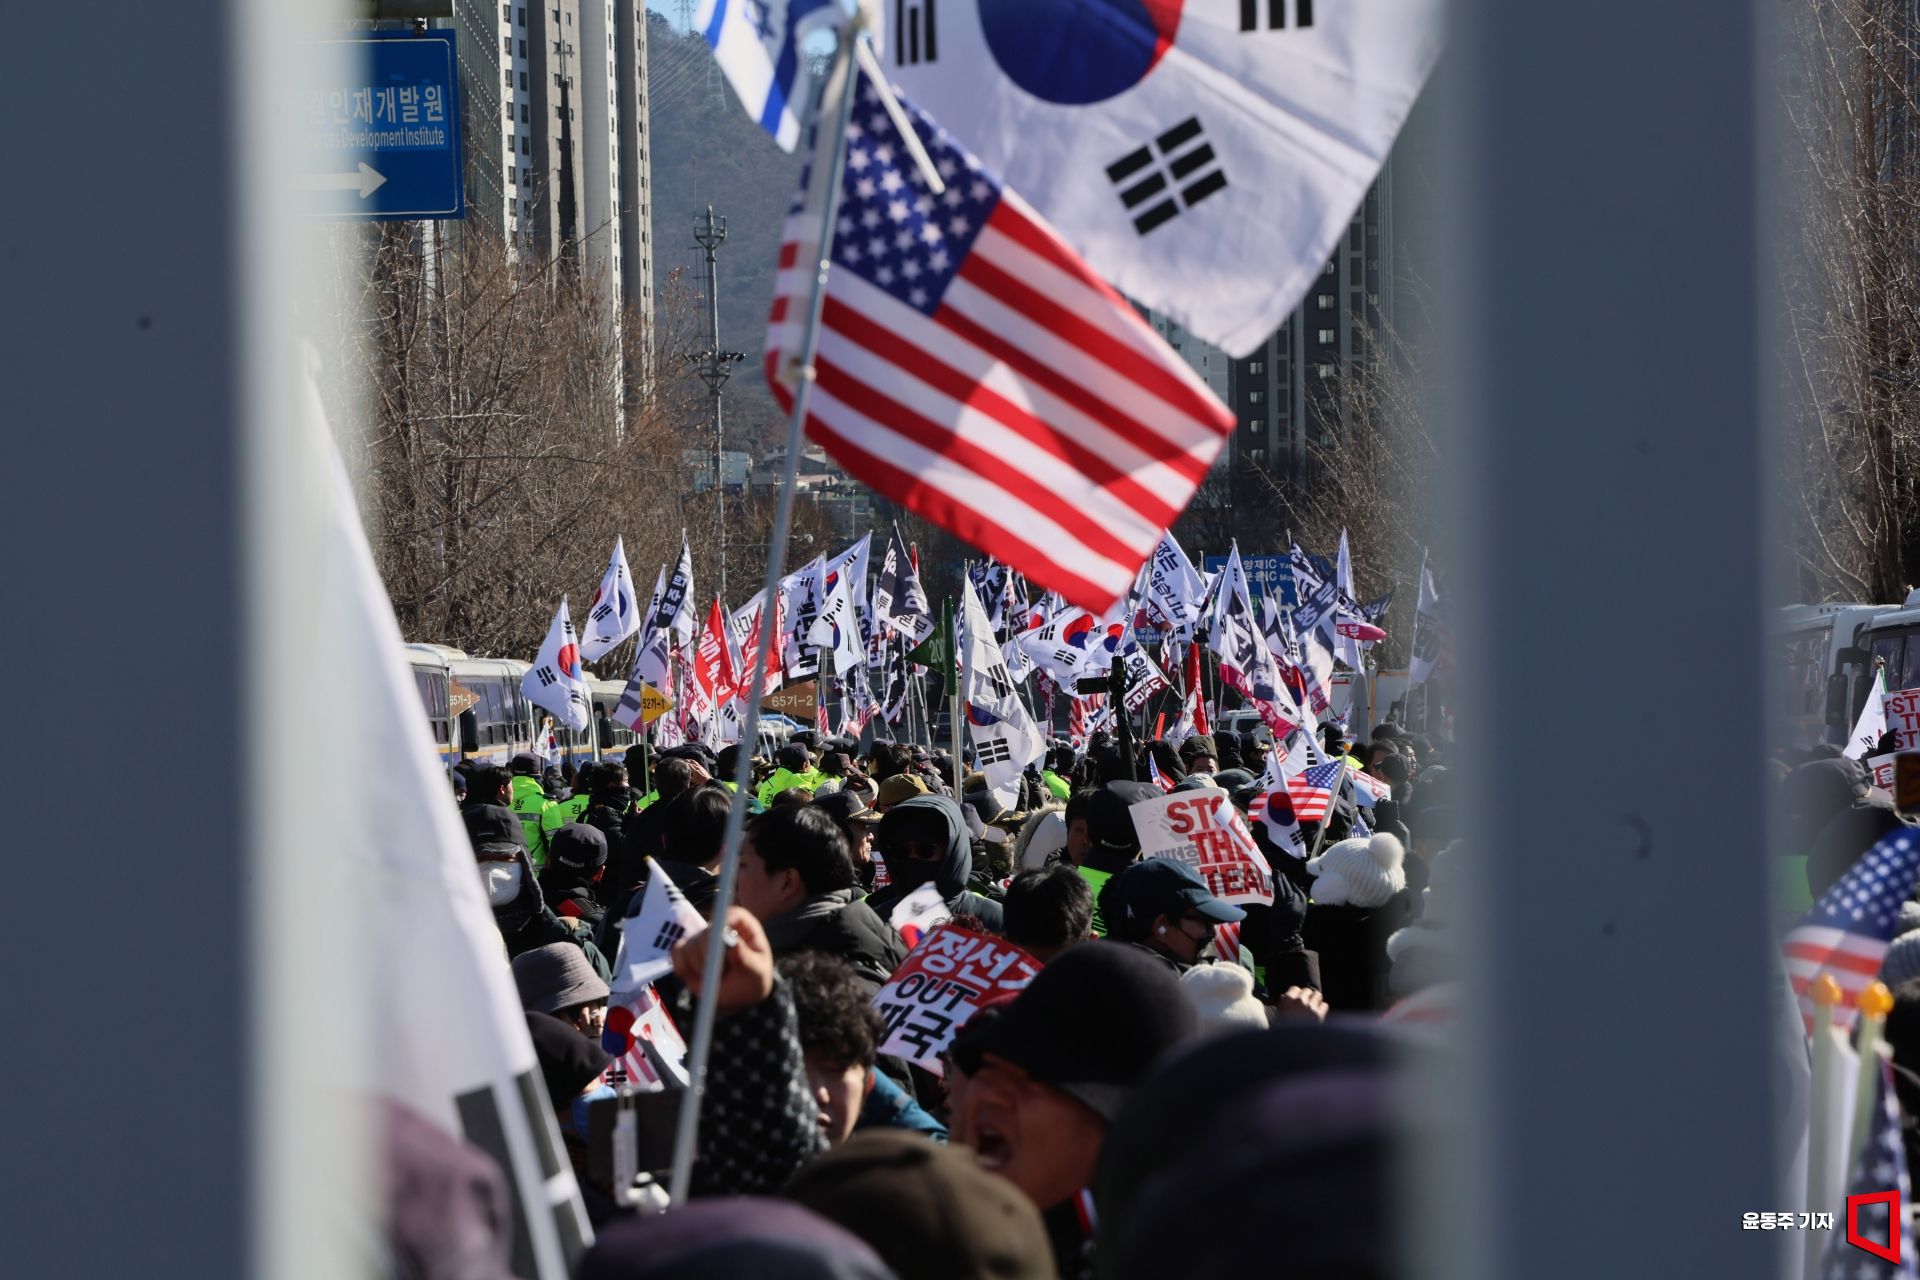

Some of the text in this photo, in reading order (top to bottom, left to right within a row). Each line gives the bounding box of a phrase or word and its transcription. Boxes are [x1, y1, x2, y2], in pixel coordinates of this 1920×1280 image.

[341, 127, 405, 151] Development
[405, 126, 445, 146] Institute
[1243, 558, 1277, 570] 양재IC
[642, 698, 665, 710] 52기-1
[772, 694, 814, 708] 65기-2
[1892, 695, 1918, 714] ST
[1167, 796, 1225, 834] STO
[1200, 861, 1273, 898] TEAL
[895, 972, 979, 1012] OUT
